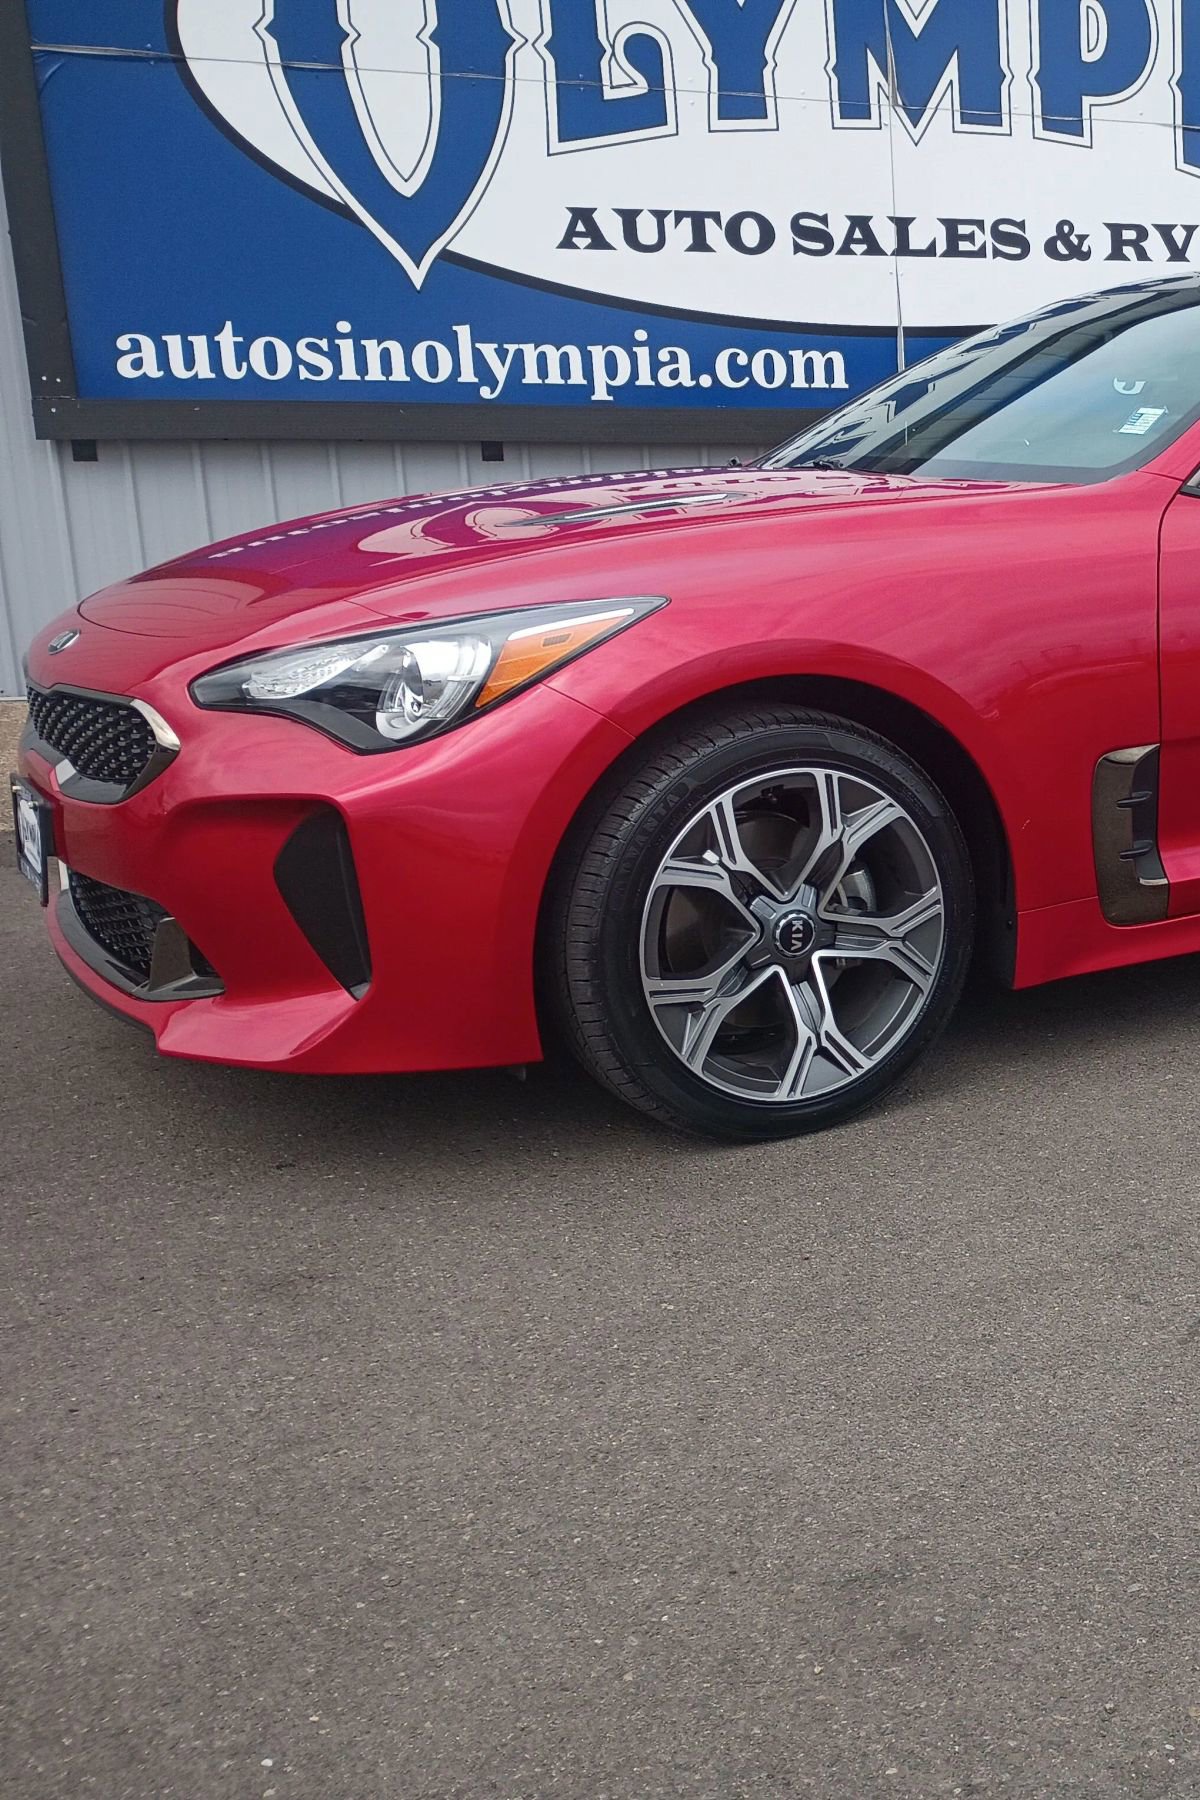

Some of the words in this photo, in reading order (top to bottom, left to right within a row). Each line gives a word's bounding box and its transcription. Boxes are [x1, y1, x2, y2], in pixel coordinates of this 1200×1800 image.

[556, 206, 776, 256] AUTO
[790, 211, 1031, 261] SALES
[1043, 219, 1092, 262] &
[1102, 222, 1200, 263] RV
[115, 320, 849, 401] autosinolympia.com
[789, 918, 804, 951] KIA
